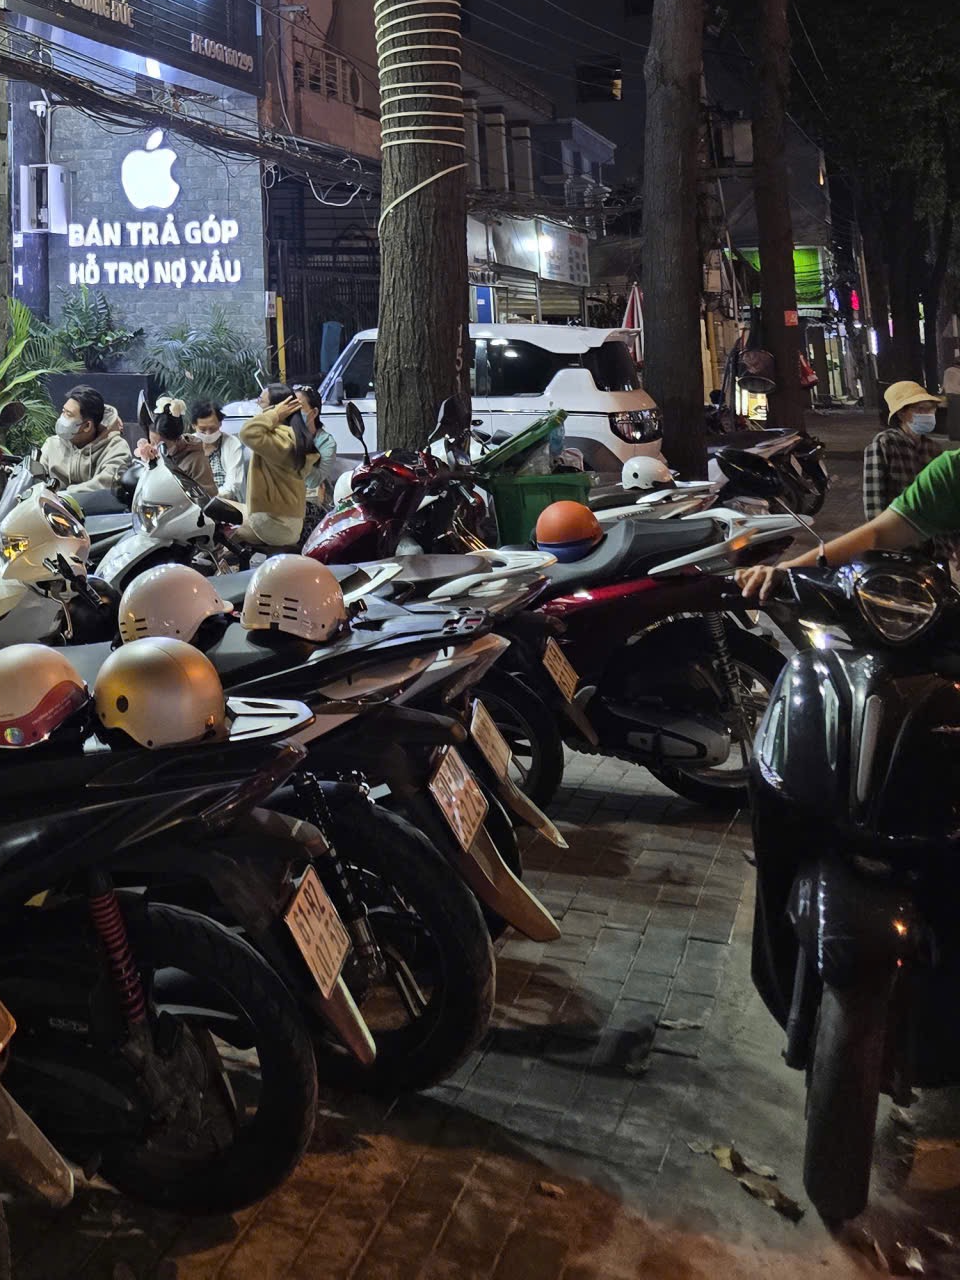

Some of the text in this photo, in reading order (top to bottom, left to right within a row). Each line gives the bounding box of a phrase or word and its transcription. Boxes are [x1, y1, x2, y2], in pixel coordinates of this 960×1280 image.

[111, 0, 135, 29] ĐỨC
[68, 213, 239, 247] BÁN TRẢ GÓP
[69, 253, 100, 285] HỖ
[103, 259, 149, 288] TRỢ
[154, 258, 187, 288] NỢ
